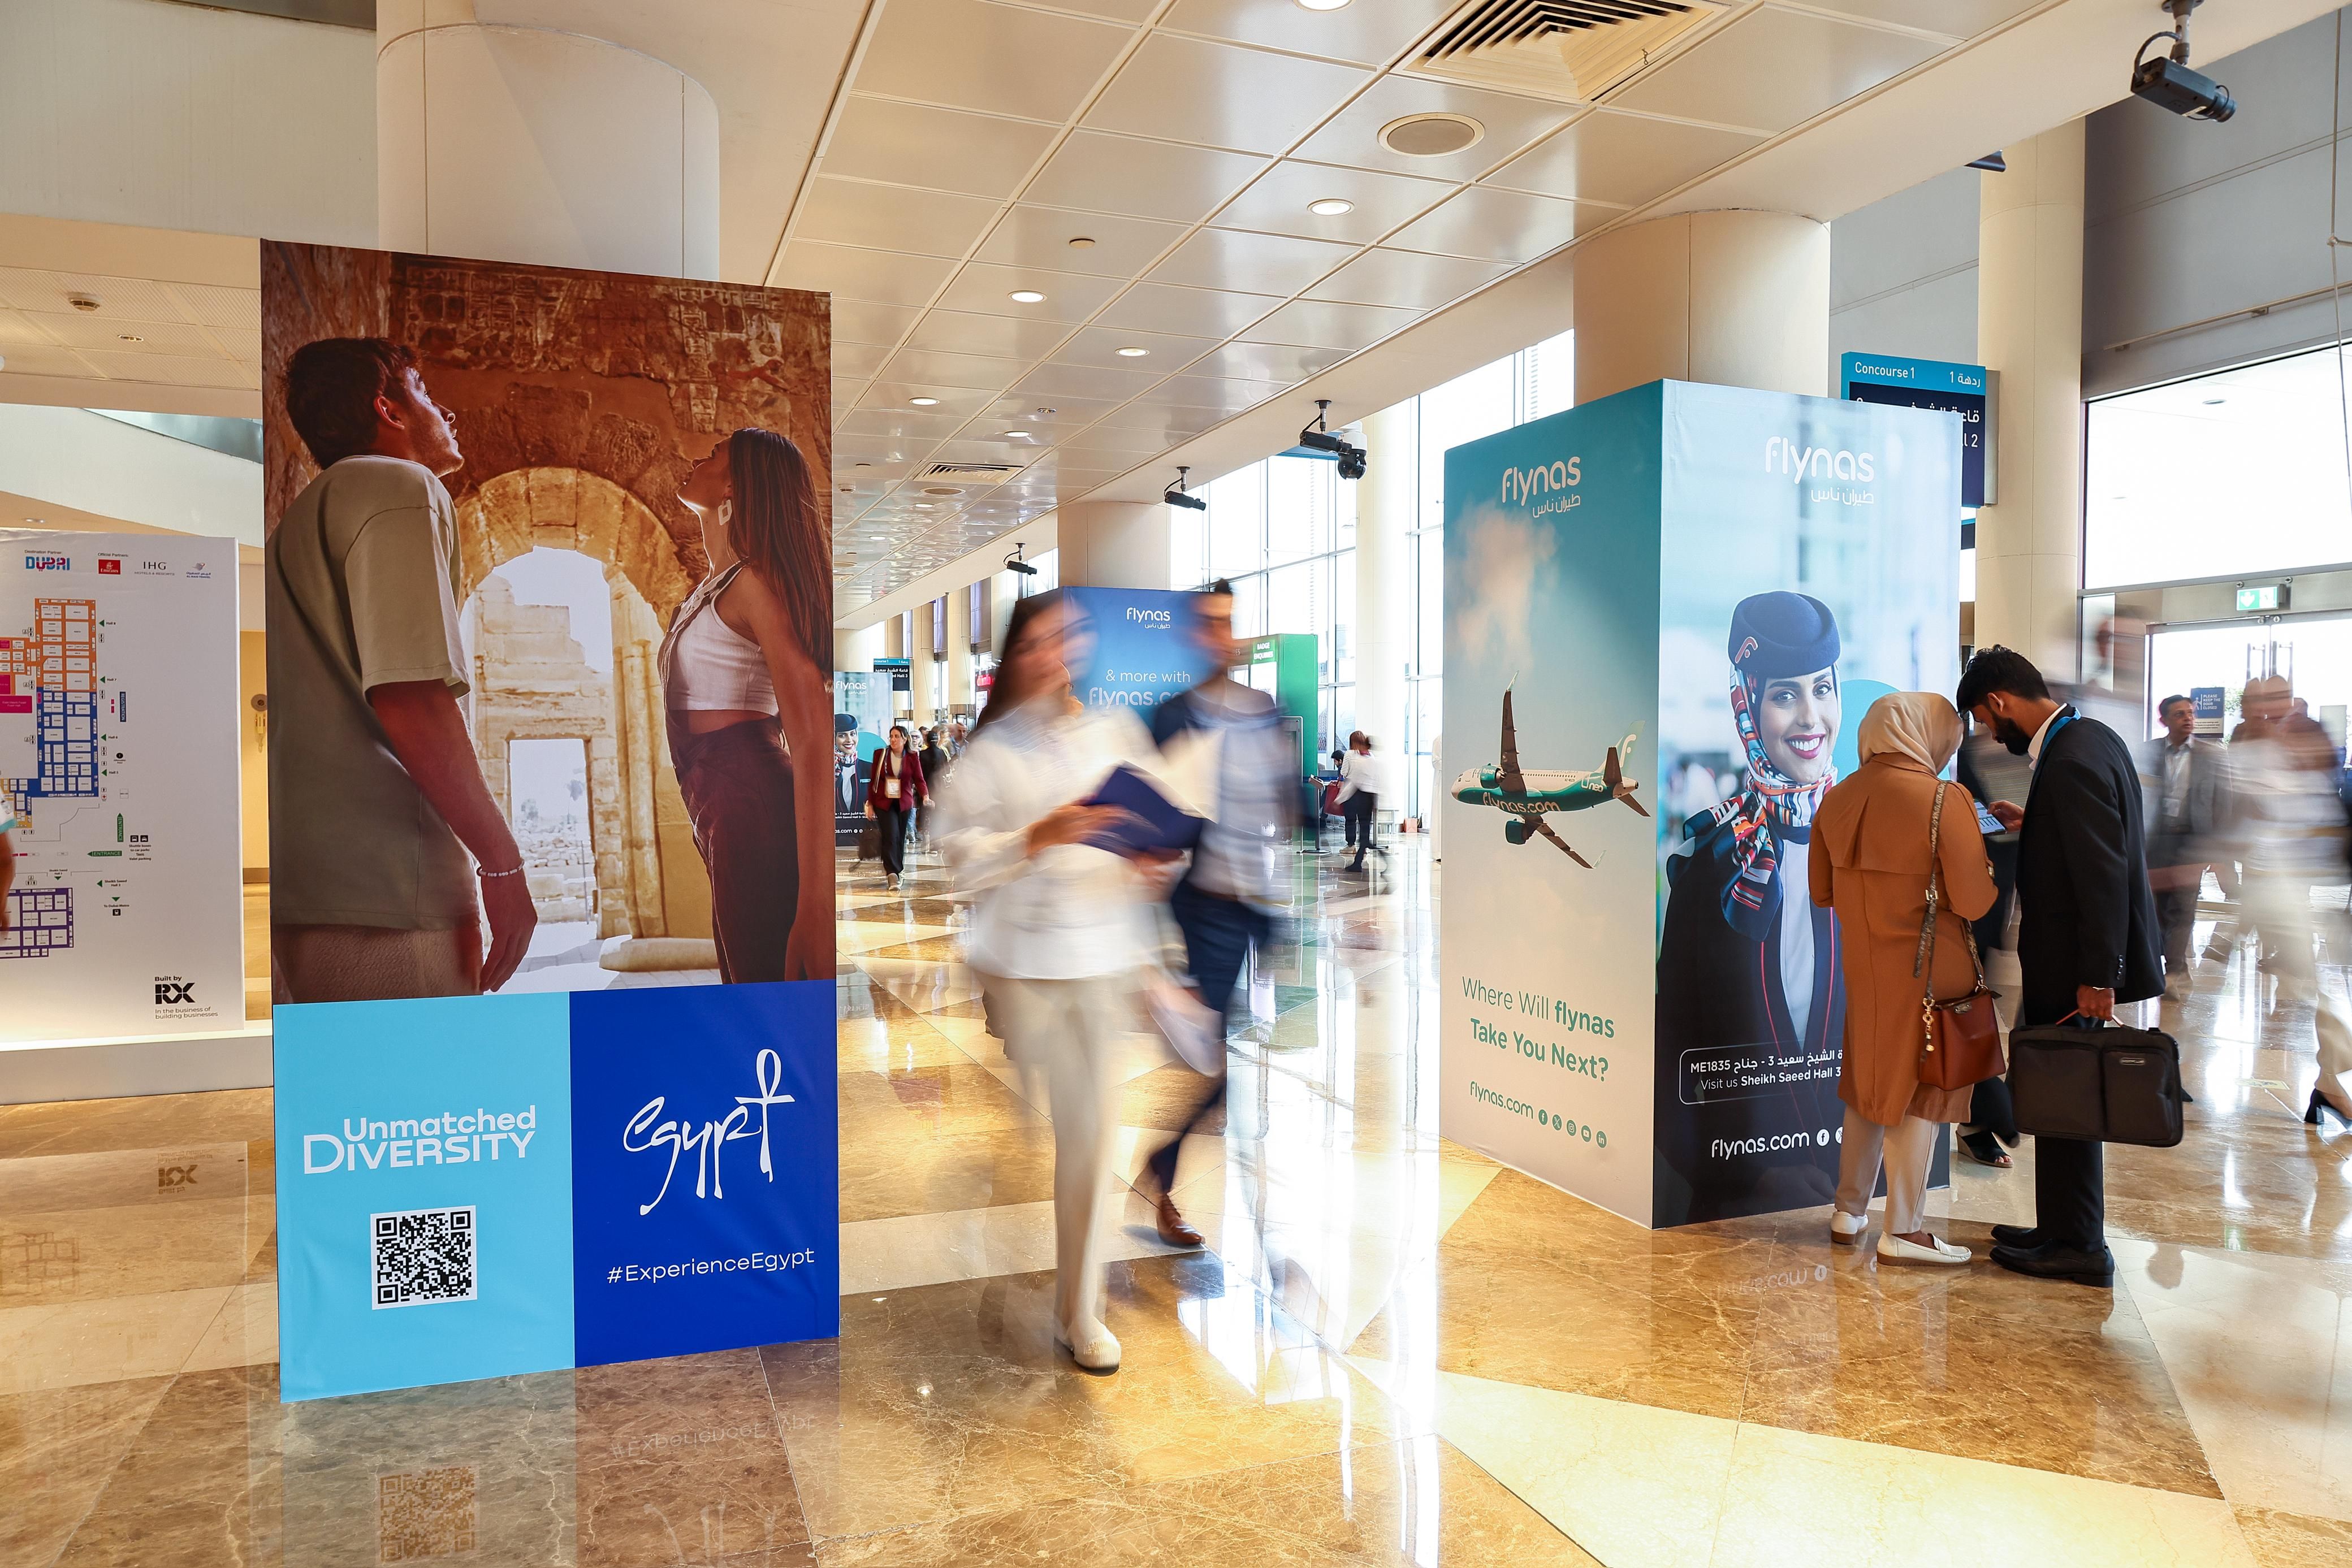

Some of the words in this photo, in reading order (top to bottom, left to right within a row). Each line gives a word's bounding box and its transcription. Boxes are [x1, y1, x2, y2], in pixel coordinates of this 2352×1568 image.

[1854, 361, 1908, 379] Concourse
[1910, 367, 1915, 379] 1
[1950, 371, 1954, 383] 1
[1958, 373, 1981, 388] ردهة
[1971, 434, 1978, 448] 2
[1765, 436, 1874, 484] flynas
[1501, 456, 1581, 505] flynas
[1556, 494, 1581, 514] طيران
[1811, 487, 1839, 503] ناس
[1842, 488, 1874, 506] طيران
[1532, 500, 1552, 518] ناس
[143, 561, 167, 570] IHG
[1126, 607, 1170, 623] flynas
[1106, 669, 1116, 682] &
[1120, 672, 1157, 682] more
[1162, 671, 1190, 683] with
[836, 681, 867, 691] flynas
[1089, 687, 1182, 709] flynas.c
[155, 982, 196, 1004] RX
[1462, 976, 1513, 1010] Where
[1518, 991, 1549, 1020] Will
[1554, 1000, 1615, 1038] flynas
[1470, 1018, 1508, 1049] Take
[1512, 1031, 1545, 1062] You
[1551, 1042, 1609, 1082] Next?
[1806, 1049, 1835, 1067] الشيخ
[1690, 1060, 1730, 1074] ME1835
[1733, 1058, 1758, 1073] جناح
[1768, 1056, 1774, 1066] 3
[1777, 1056, 1804, 1066] سعيد
[1701, 1077, 1723, 1090] Visit
[1726, 1079, 1738, 1088] us
[1741, 1072, 1776, 1087] Sheikh
[1778, 1069, 1811, 1083] Saeed
[1814, 1067, 1833, 1079] Hall
[1835, 1067, 1841, 1077] 3
[1470, 1081, 1534, 1120] flynas.com
[343, 1104, 536, 1143] Unmatched
[304, 1131, 534, 1174] DIVERSITY
[1711, 1130, 1810, 1160] flynas.com
[607, 1247, 815, 1284] #ExperienceEgypt
